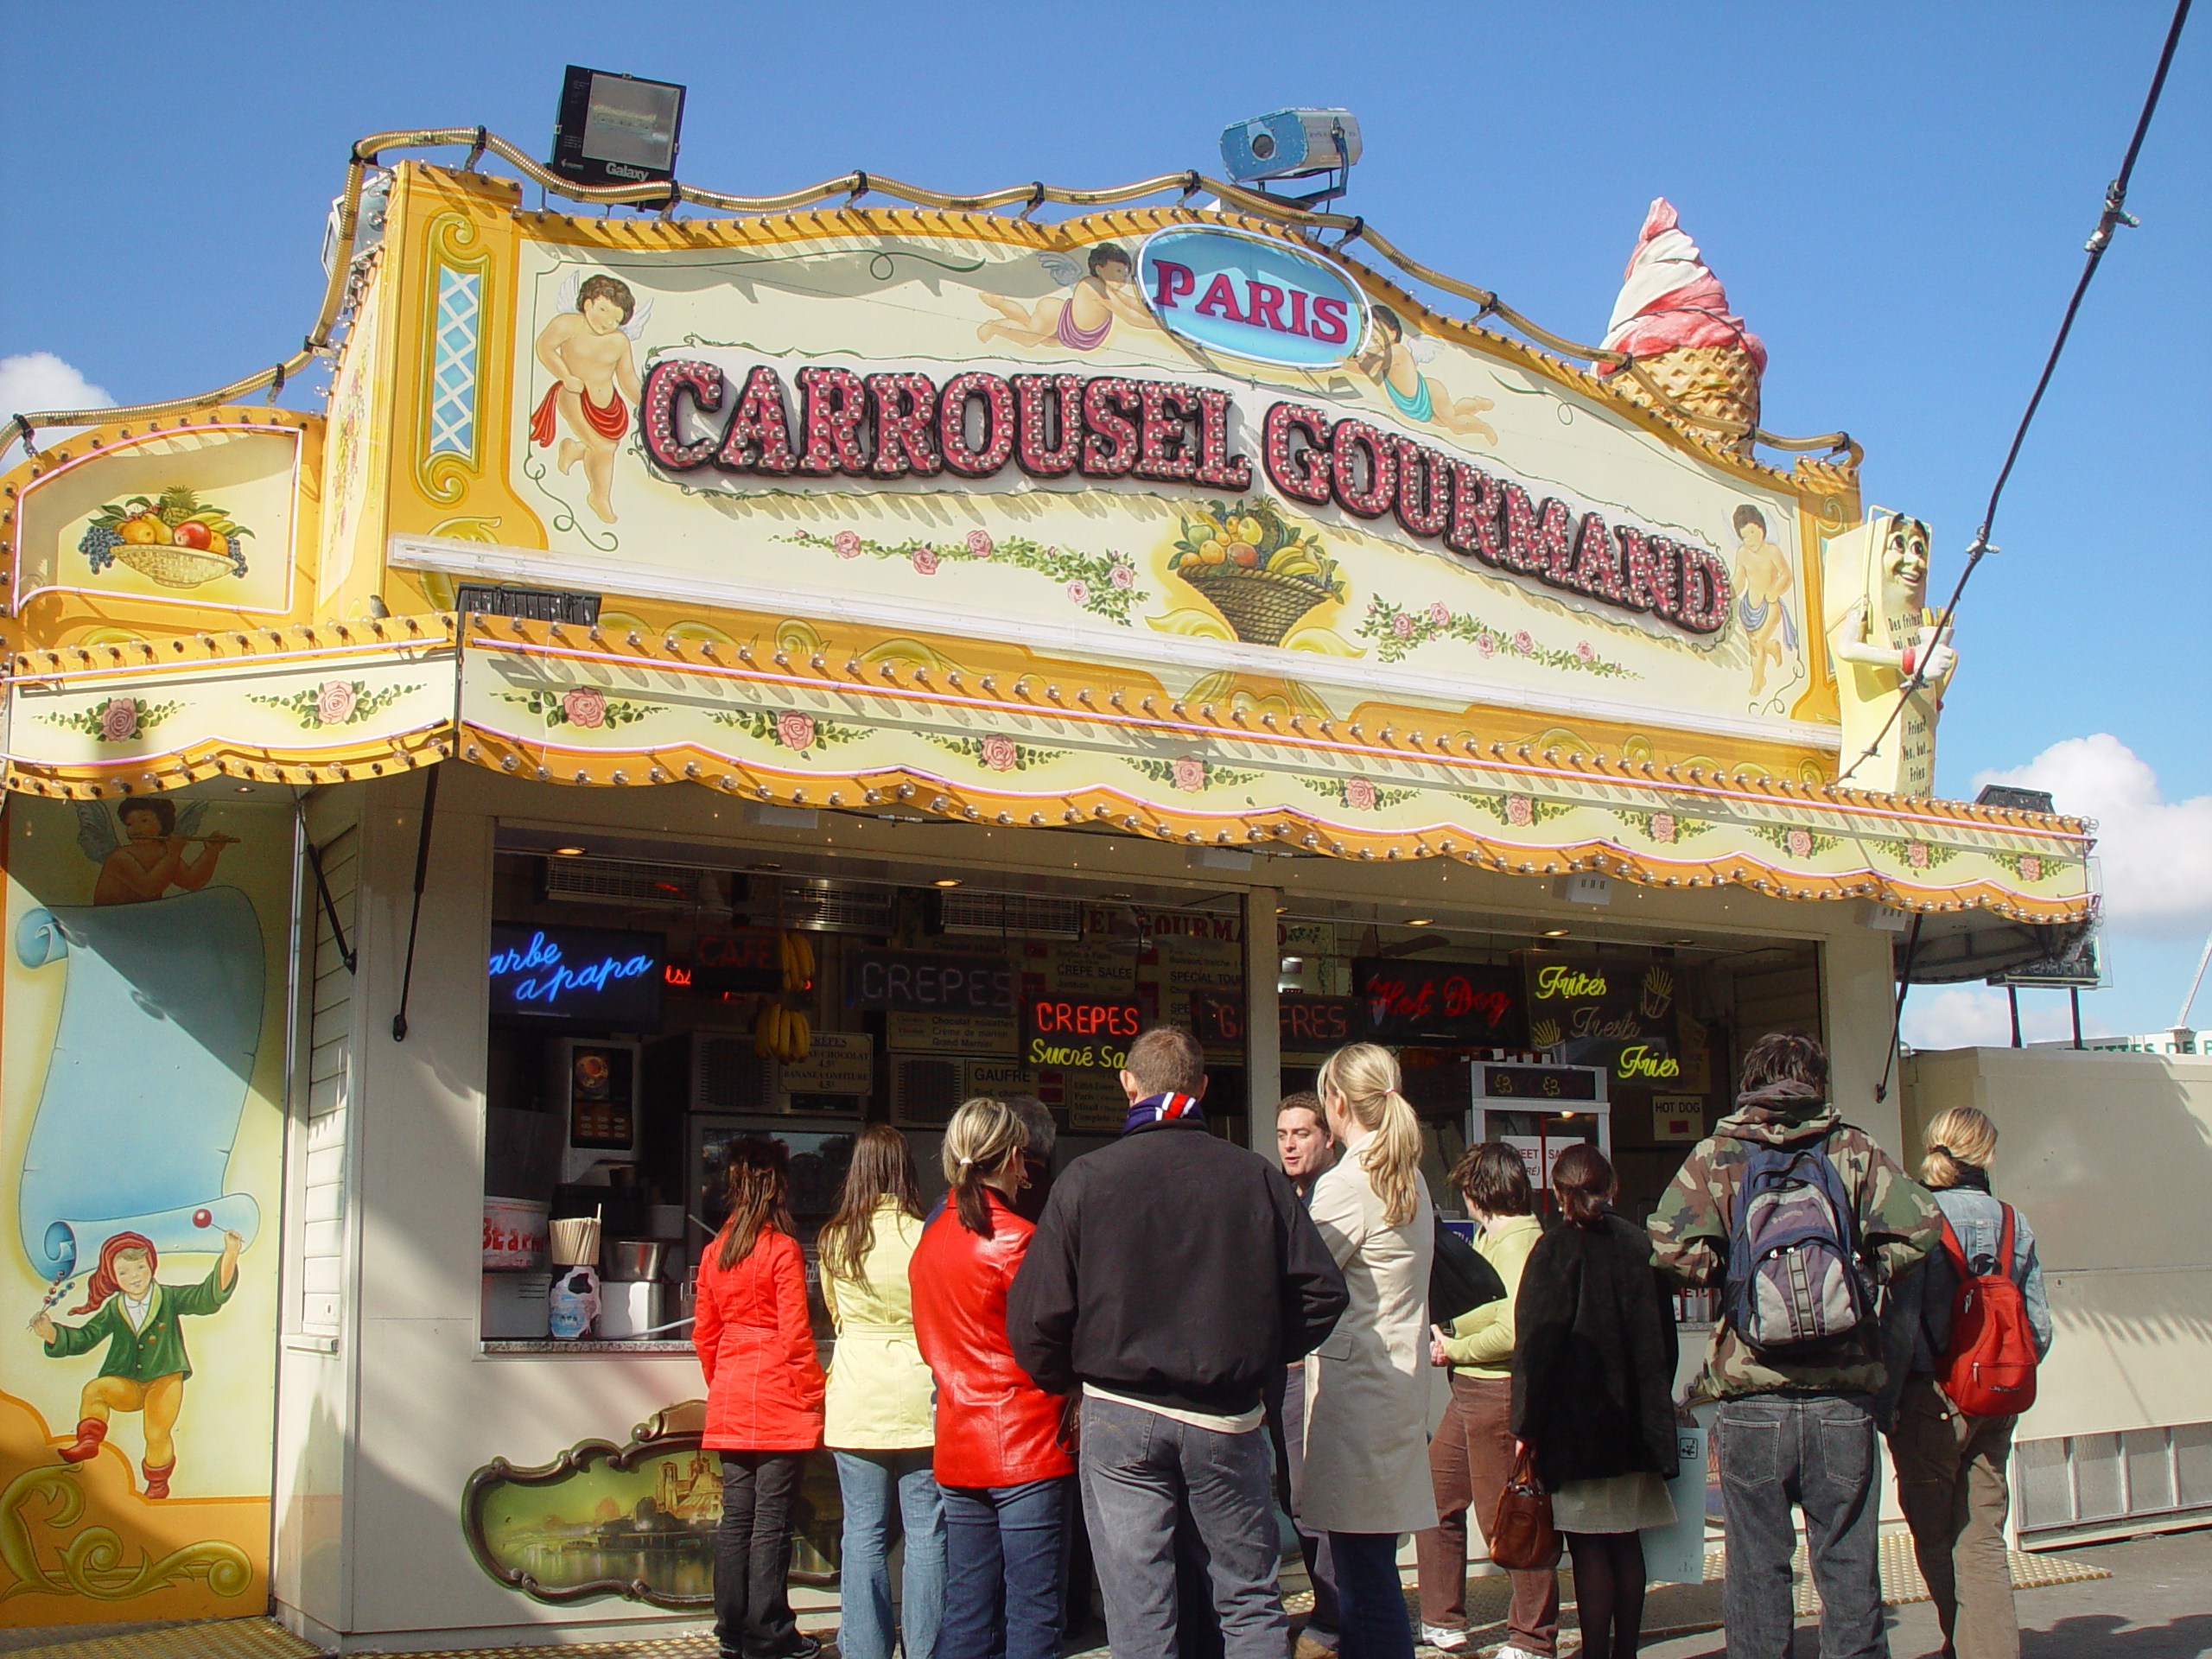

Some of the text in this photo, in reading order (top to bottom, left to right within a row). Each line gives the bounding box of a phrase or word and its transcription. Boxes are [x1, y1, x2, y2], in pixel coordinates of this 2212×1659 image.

[606, 162, 649, 182] Galaxy
[1152, 259, 1348, 344] PARIS
[640, 359, 1729, 634] CARROUSEL GOURMAND
[1908, 715, 1927, 735] Fries?
[1910, 766, 1925, 782] Fries
[861, 962, 1014, 1007] CREPES
[1367, 975, 1512, 1026] Hot Dog
[931, 1016, 970, 1026] Chocolat
[1036, 1001, 1139, 1036] CREPES
[1570, 1006, 1641, 1040] Fresh
[1028, 1038, 1095, 1066] Sucré
[1616, 1044, 1681, 1079] Fries
[974, 1068, 1031, 1083] GAUFRE
[1656, 1103, 1700, 1113] HOT DOG
